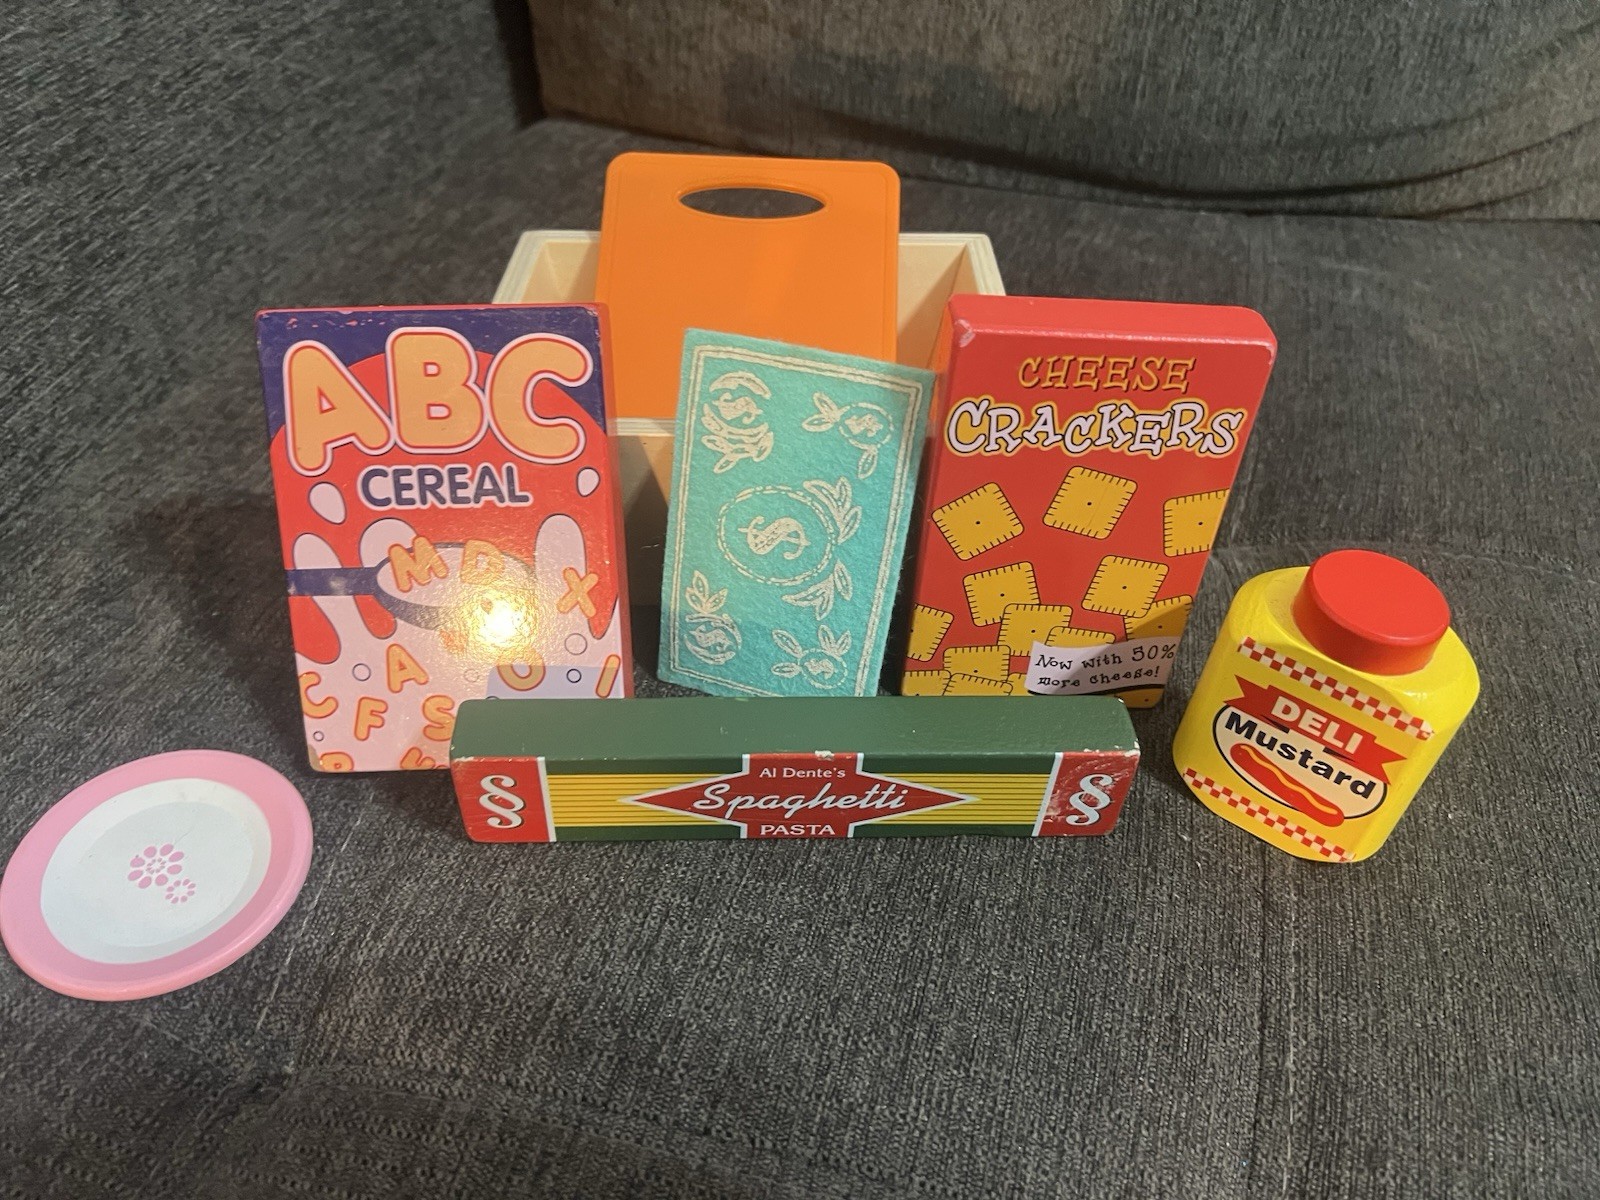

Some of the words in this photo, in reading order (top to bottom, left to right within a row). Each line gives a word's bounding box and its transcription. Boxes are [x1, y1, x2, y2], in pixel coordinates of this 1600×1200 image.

[1018, 356, 1197, 393] CHEESE
[283, 327, 594, 476] ABC
[949, 398, 1245, 457] CRACKERS
[359, 464, 532, 508] CEREAL
[388, 536, 449, 593] M
[556, 567, 599, 618] X
[386, 643, 429, 694] A
[1035, 654, 1073, 671] Now
[1081, 653, 1123, 670] with
[1131, 643, 1177, 663] 50%
[1037, 676, 1081, 689] more
[354, 696, 388, 741] F
[1270, 696, 1363, 754] DELI
[759, 767, 777, 778] Al
[782, 767, 846, 778] Dente's
[1225, 711, 1377, 800] Mustard
[693, 782, 908, 819] Spaghetti
[760, 824, 836, 836] PASTA
